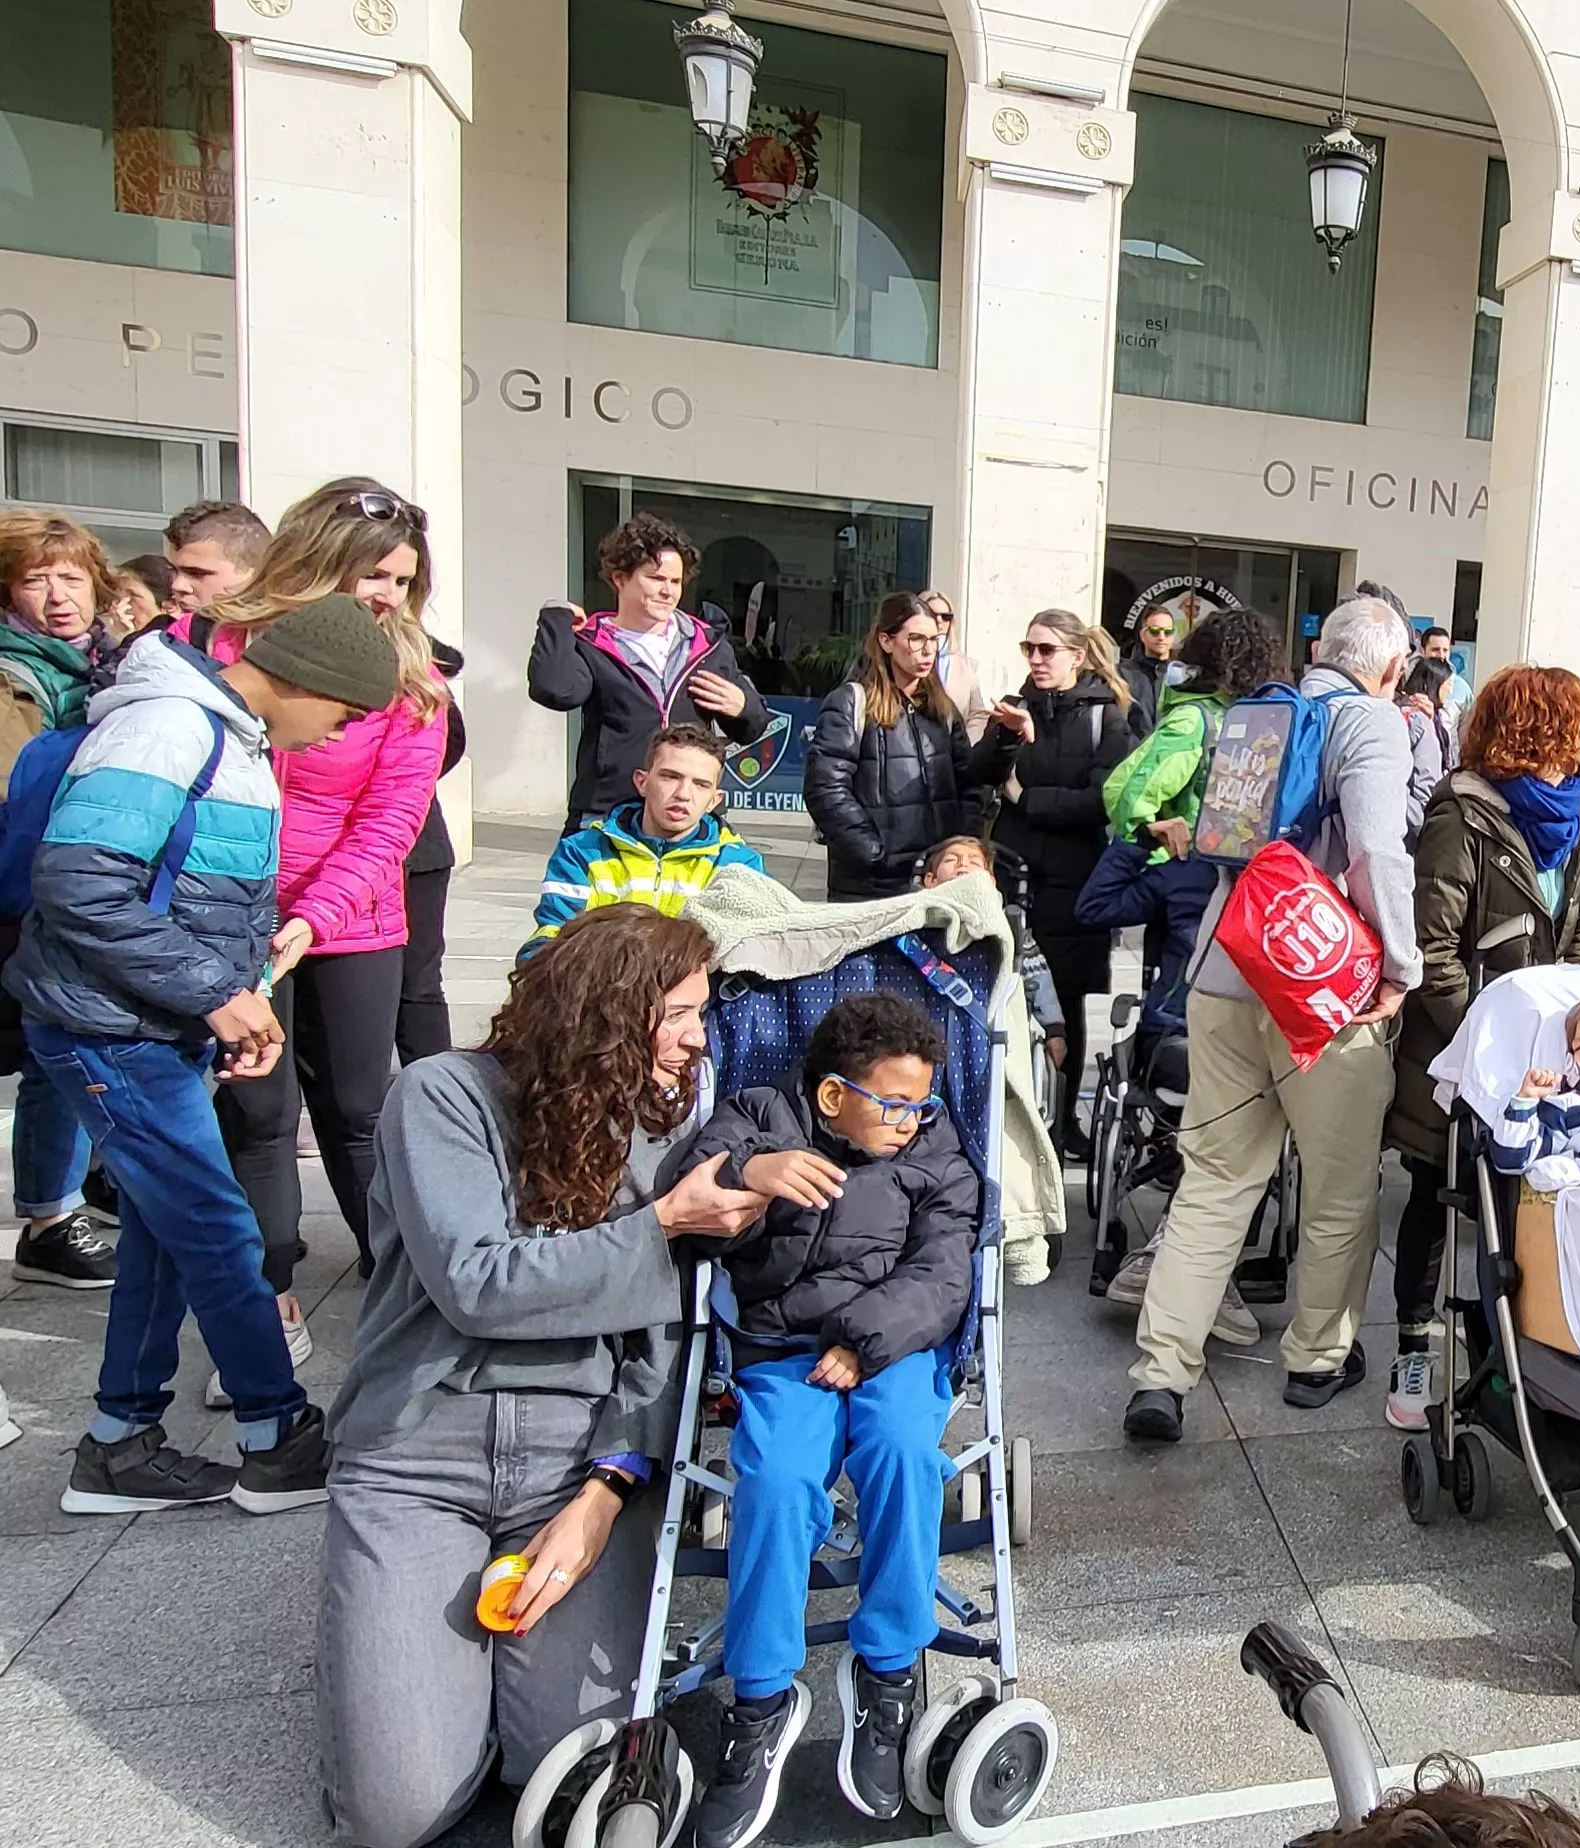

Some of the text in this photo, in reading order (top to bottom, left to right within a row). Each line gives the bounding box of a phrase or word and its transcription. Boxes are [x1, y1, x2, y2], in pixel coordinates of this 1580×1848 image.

[1145, 317, 1168, 333] es!
[1262, 459, 1489, 520] OFICINA
[1123, 575, 1204, 631] BIENVENIDOS
[733, 790, 753, 809] DE
[755, 791, 807, 812] LEYEN
